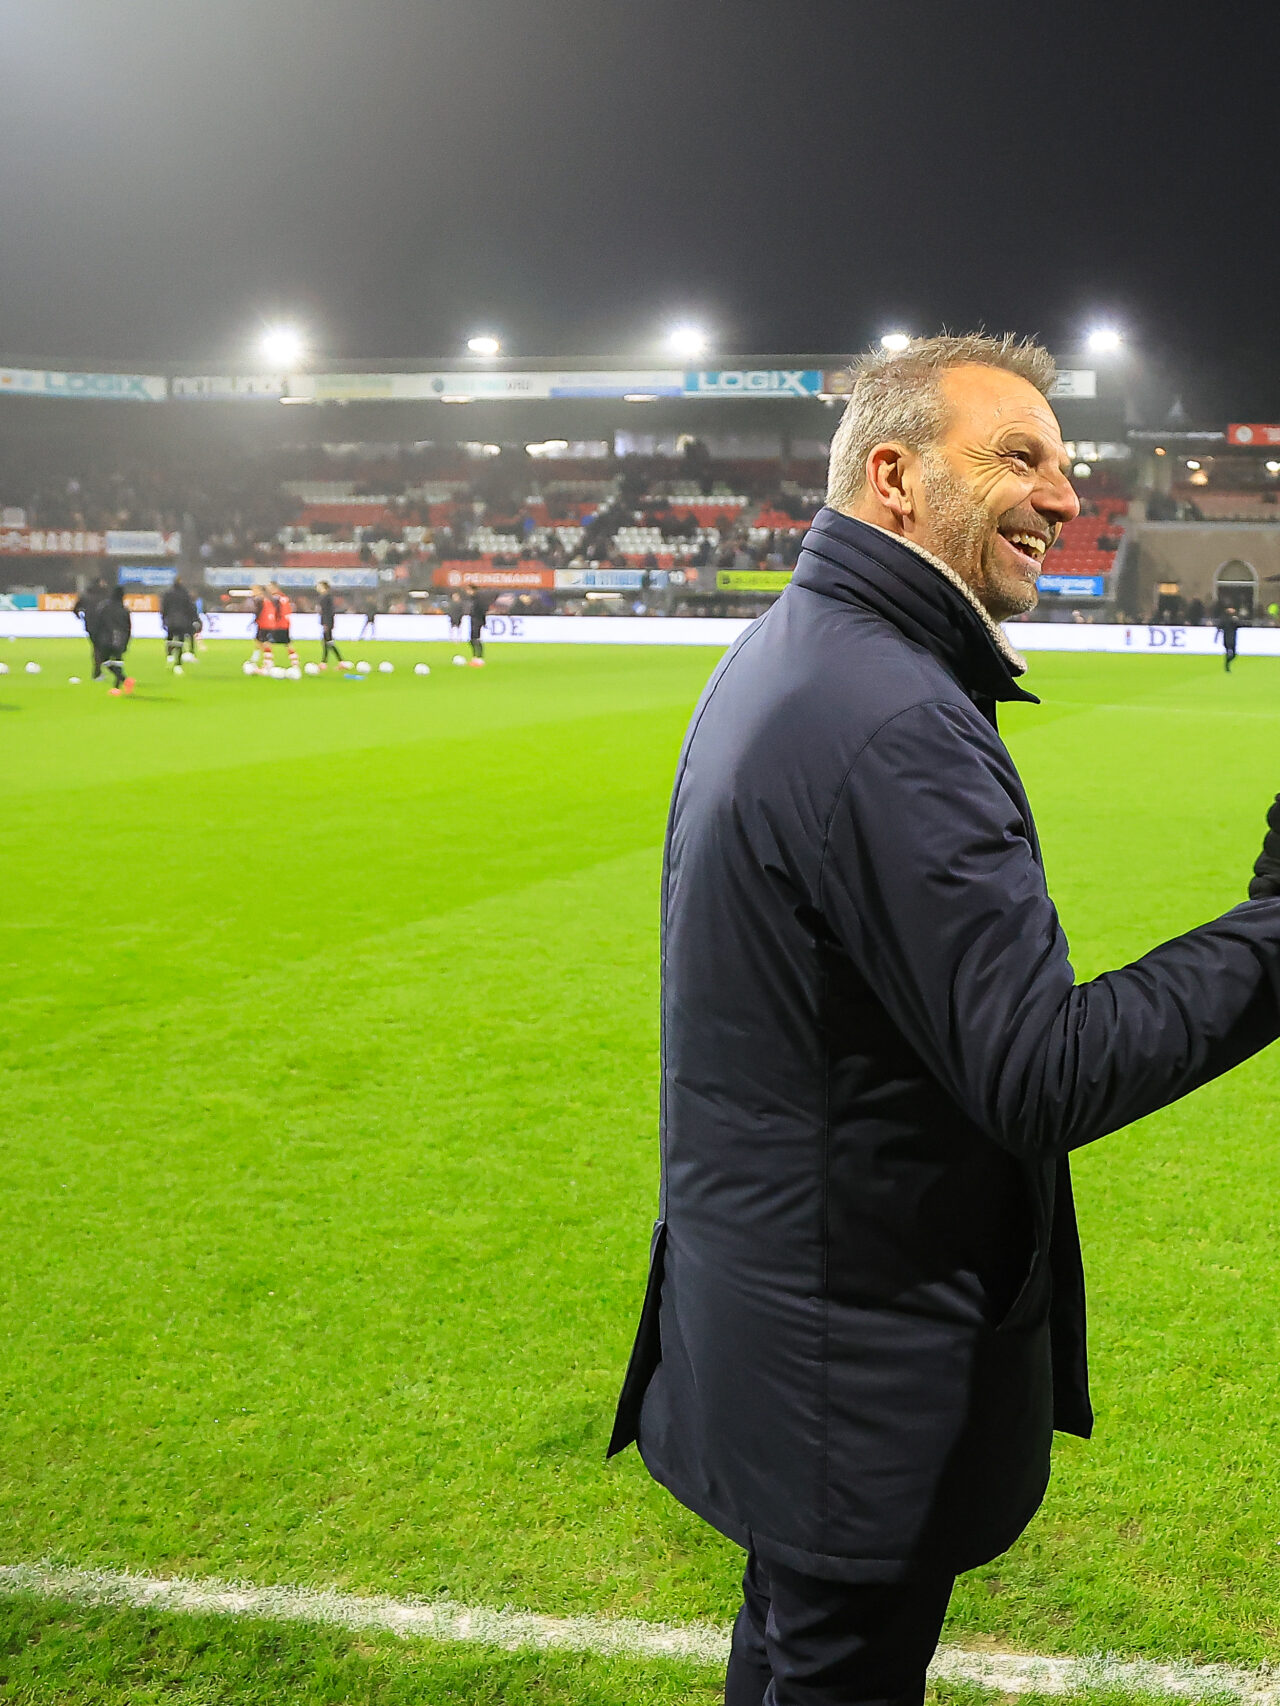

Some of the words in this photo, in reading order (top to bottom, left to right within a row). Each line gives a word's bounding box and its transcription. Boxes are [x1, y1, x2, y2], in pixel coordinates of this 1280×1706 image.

[698, 370, 814, 397] LOGIX
[490, 617, 524, 636] DE
[1148, 626, 1186, 647] DE
